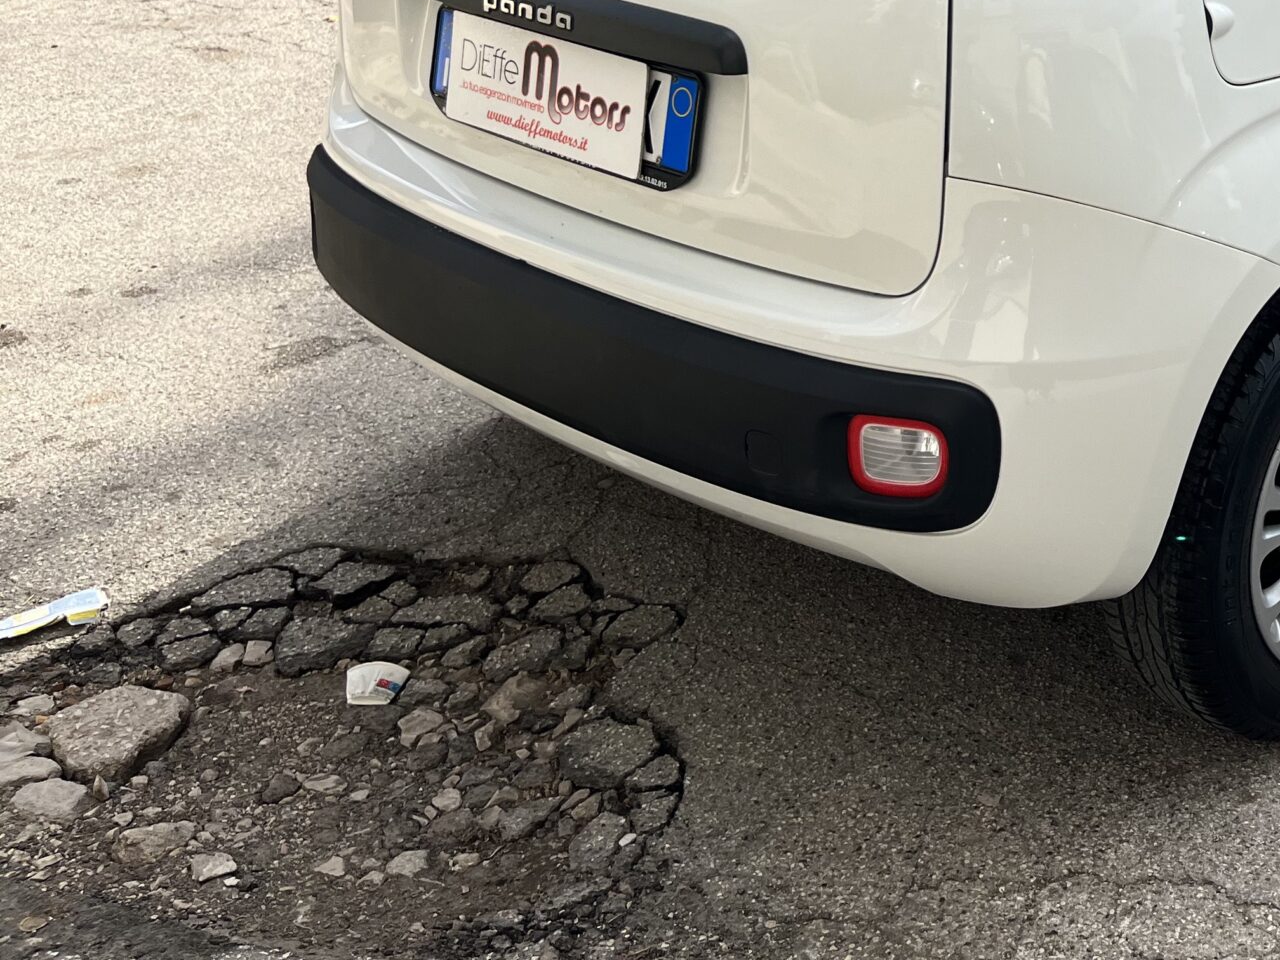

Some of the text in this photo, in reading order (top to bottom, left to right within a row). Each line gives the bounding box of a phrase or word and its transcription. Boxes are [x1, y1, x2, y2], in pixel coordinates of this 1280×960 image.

[461, 38, 519, 85] DiEffe
[521, 40, 631, 132] Motors
[487, 108, 589, 151] www.dieffemotors.it
